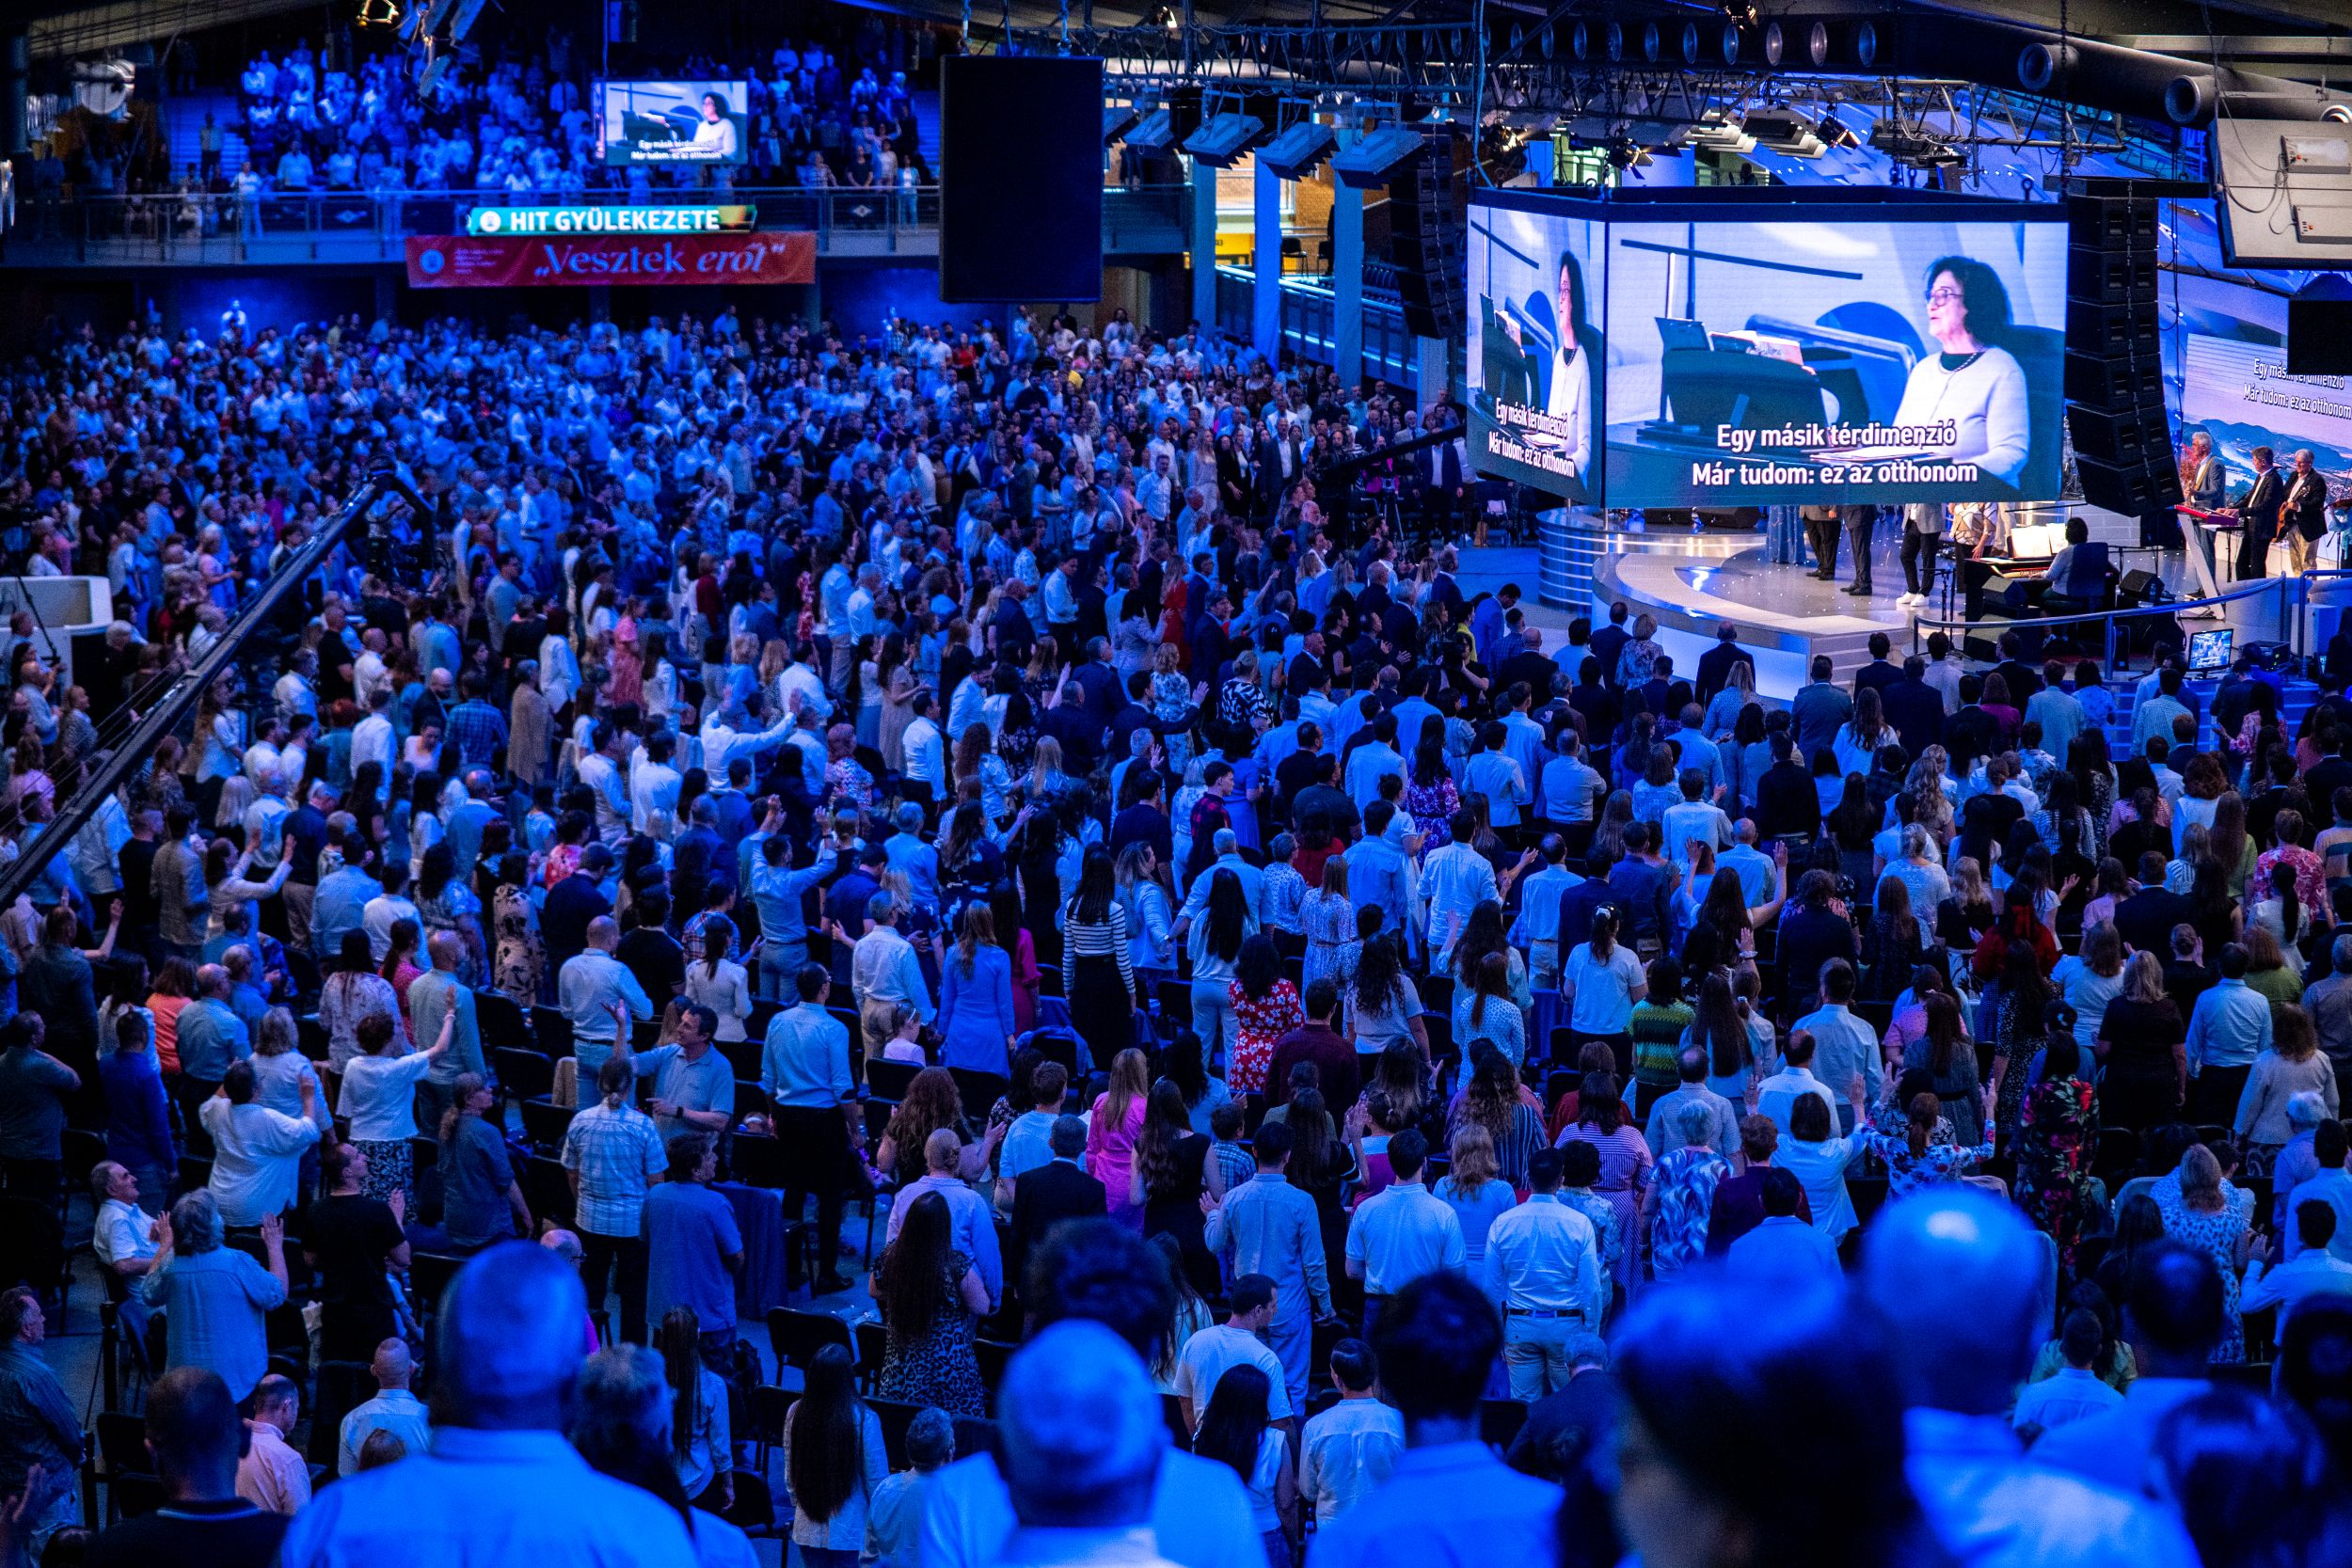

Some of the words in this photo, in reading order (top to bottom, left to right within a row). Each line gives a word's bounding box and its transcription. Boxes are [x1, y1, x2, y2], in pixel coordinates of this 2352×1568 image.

[510, 211, 549, 231] HIT
[555, 207, 721, 231] GYÜLEKEZETE
[2253, 357, 2269, 380] Egy
[1496, 397, 1508, 425] Egy
[1508, 402, 1528, 426] másik
[1528, 405, 1568, 437] térdimenzió
[2244, 383, 2260, 402] Már
[2261, 387, 2288, 407] tudom:
[2290, 395, 2299, 410] ez
[2300, 398, 2311, 412] az
[2312, 397, 2352, 420] otthonom
[1717, 423, 1756, 452] Egy
[1760, 421, 1826, 447] másik
[1830, 420, 1956, 446] térdimenzió
[1488, 431, 1502, 454] Már
[1502, 437, 1524, 463] tudom:
[1525, 448, 1533, 465] ez
[1534, 450, 1541, 467] az
[1542, 447, 1575, 478] otthonom
[1692, 461, 1735, 485] Már
[1740, 462, 1815, 485] tudom:
[1820, 466, 1844, 483] ez
[1849, 466, 1873, 483] az
[1877, 460, 1978, 483] otthonom
